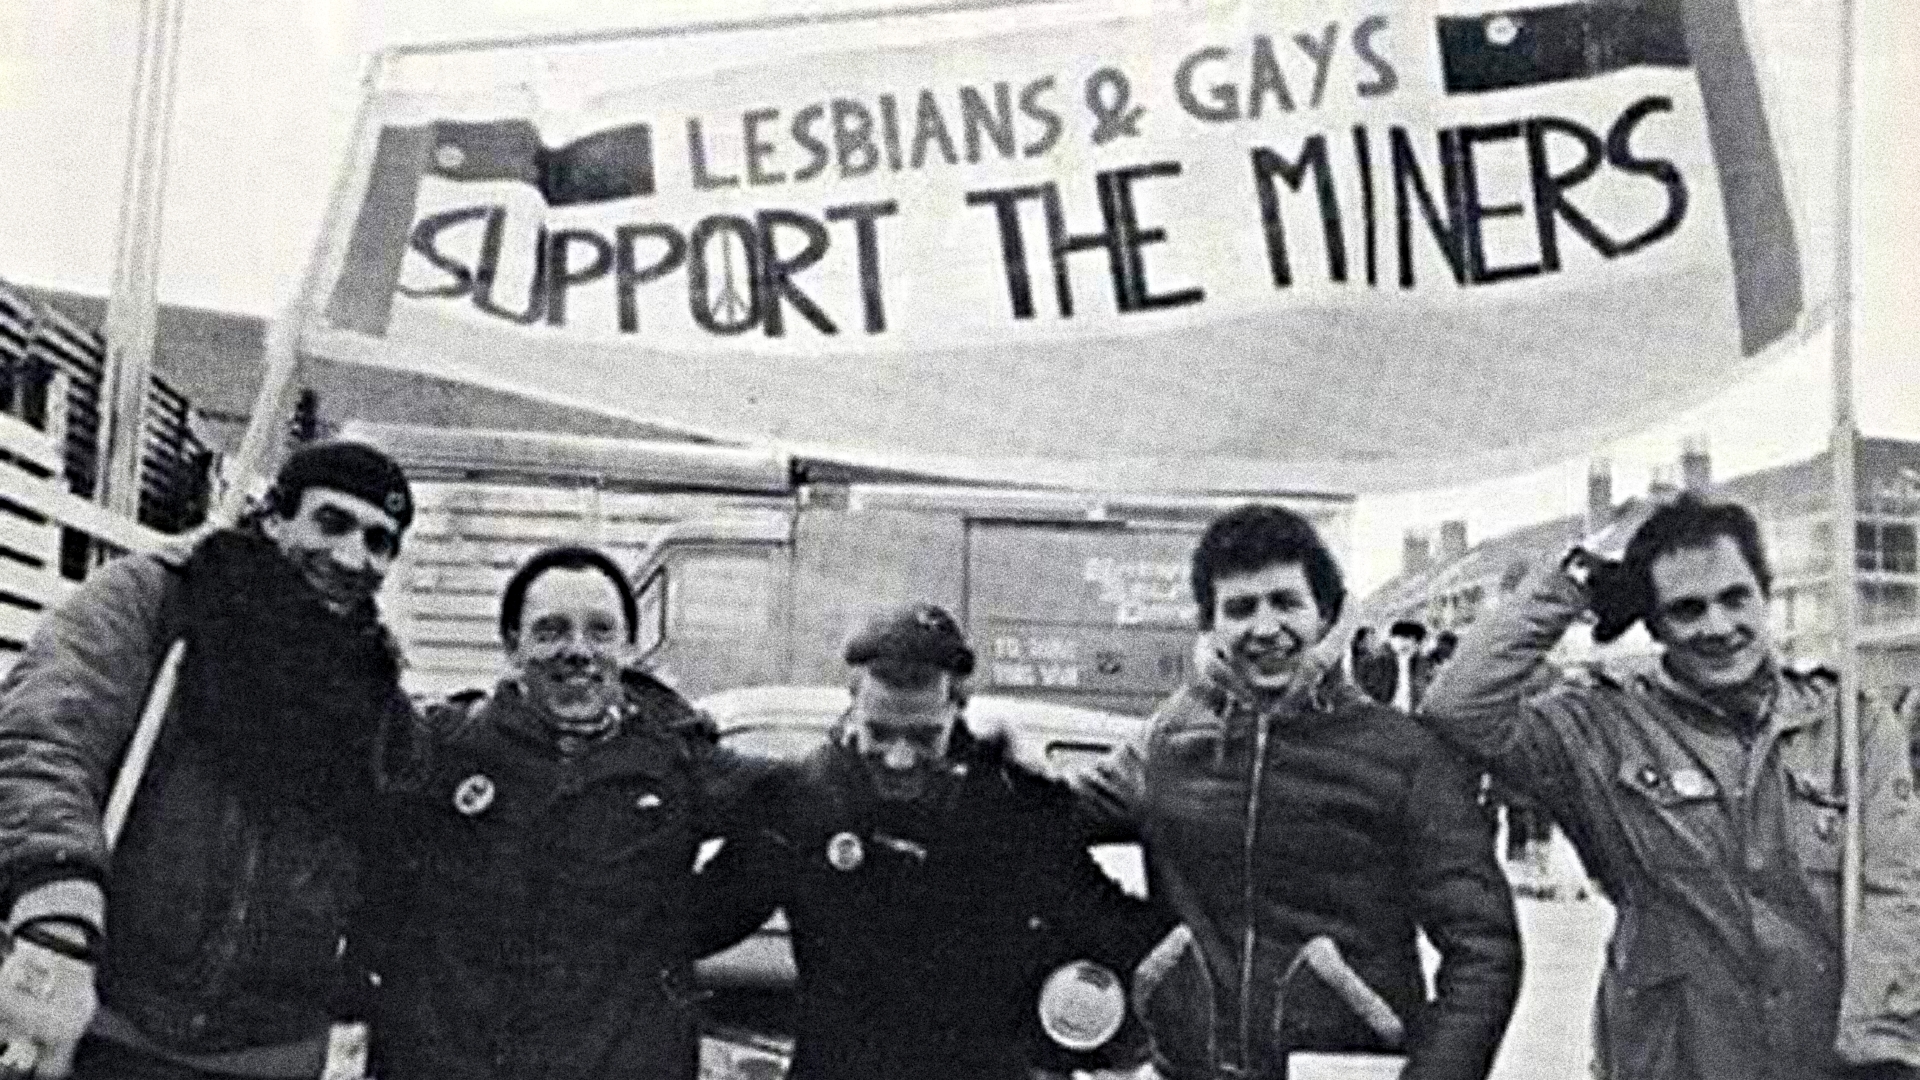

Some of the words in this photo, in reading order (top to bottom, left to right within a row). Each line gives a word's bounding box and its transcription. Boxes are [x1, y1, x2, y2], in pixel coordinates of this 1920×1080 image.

[687, 78, 1062, 191] LESBIANS
[1084, 67, 1146, 144] &
[1174, 16, 1398, 122] GAYS
[401, 200, 897, 337] SUPPORT
[966, 161, 1204, 319] THE
[1251, 96, 1689, 288] MINERS
